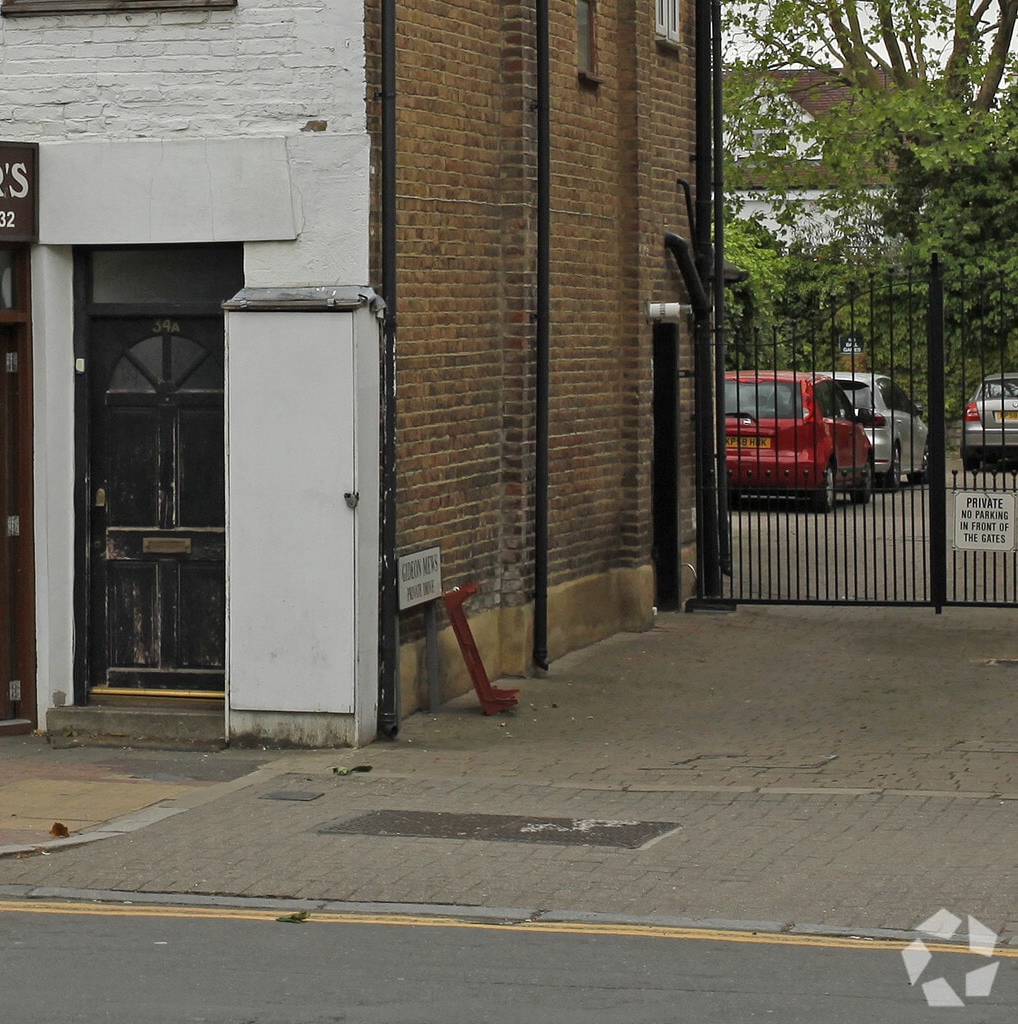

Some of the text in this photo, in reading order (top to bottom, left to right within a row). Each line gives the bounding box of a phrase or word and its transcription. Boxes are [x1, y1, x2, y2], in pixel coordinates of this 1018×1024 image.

[966, 497, 1003, 509] PRIVATE
[961, 510, 1009, 520] NO PARKING
[960, 522, 1009, 532] IN FRONT OF
[964, 533, 1006, 543] THE GATES
[422, 554, 439, 575] MEWS
